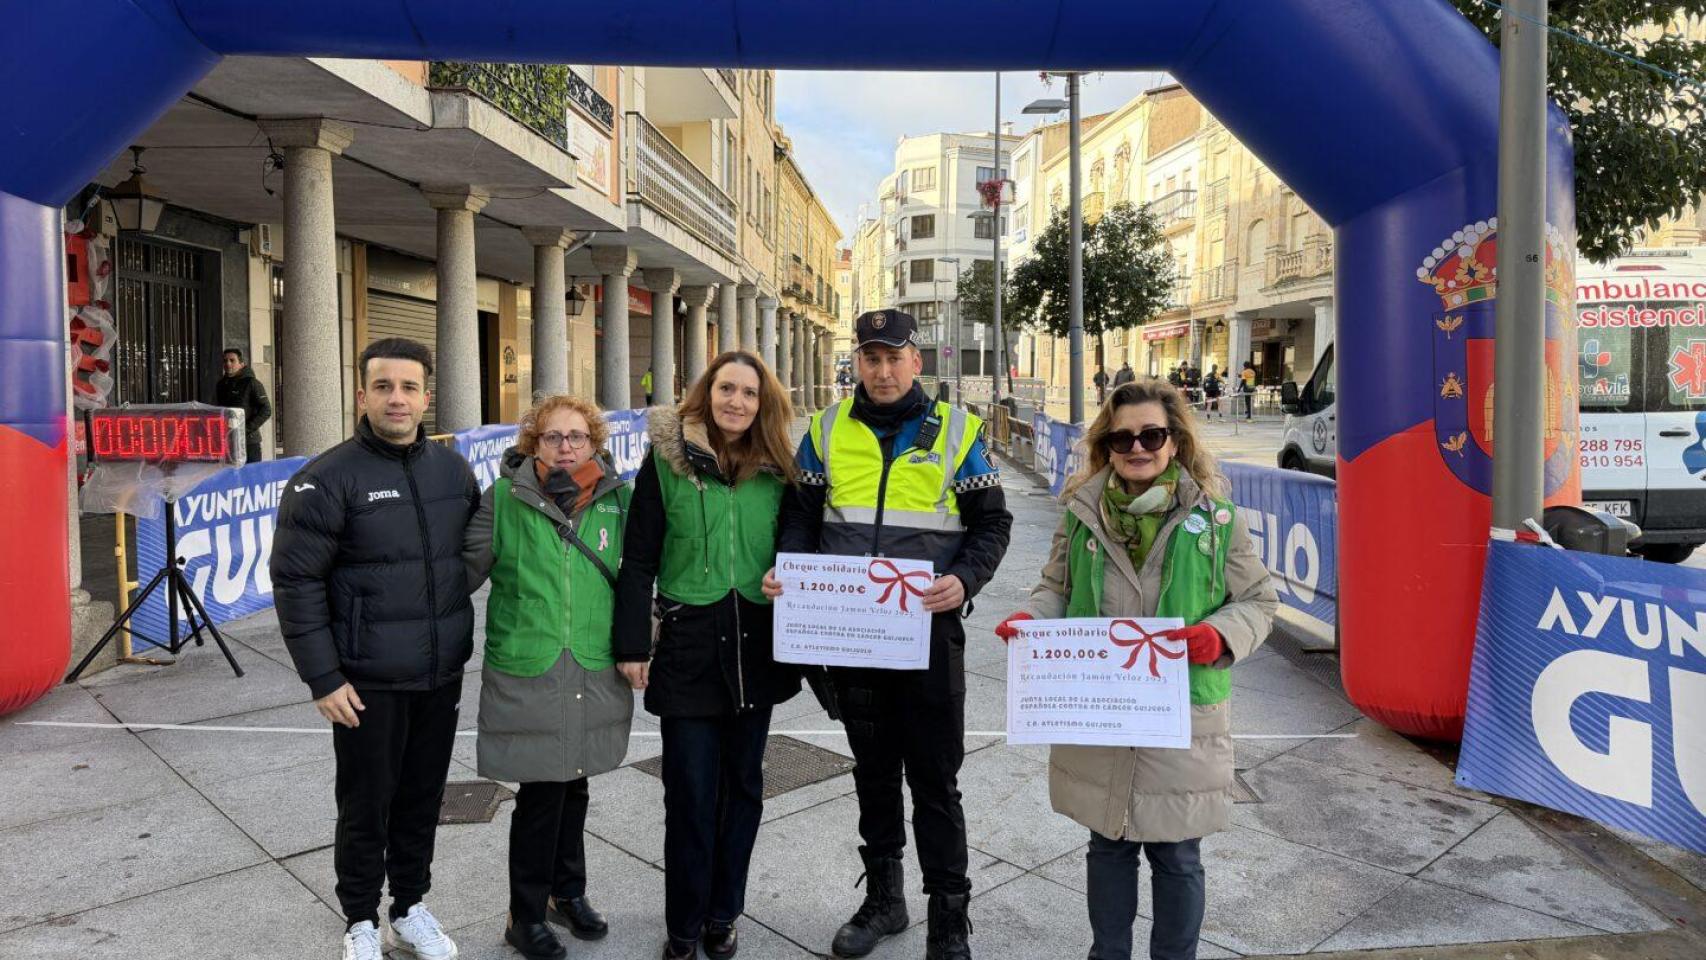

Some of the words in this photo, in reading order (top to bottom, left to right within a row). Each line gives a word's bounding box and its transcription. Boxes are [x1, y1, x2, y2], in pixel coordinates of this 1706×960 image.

[1577, 304, 1706, 328] sistenci
[1579, 439, 1608, 452] 288
[1614, 439, 1642, 452] 795
[1580, 456, 1609, 467] 810
[1614, 455, 1643, 467] 954
[174, 479, 289, 528] AYUNTAMIE
[1604, 503, 1629, 515] KFK
[783, 560, 818, 573] Cheque
[822, 562, 867, 574] solidario
[799, 581, 866, 594] 1.200,00€
[1056, 626, 1108, 637] solidario
[1032, 649, 1109, 660] 1.200,00€
